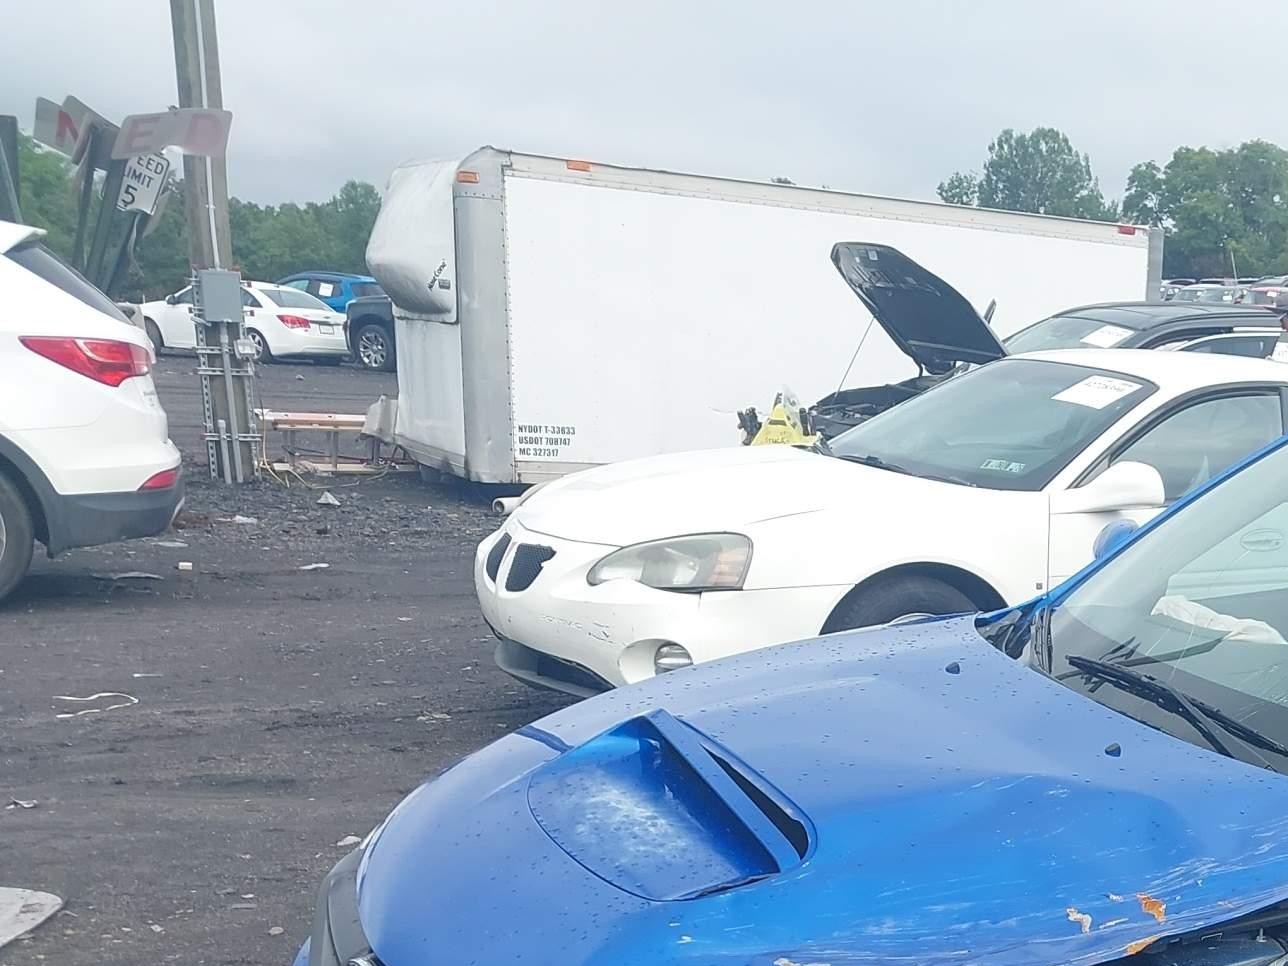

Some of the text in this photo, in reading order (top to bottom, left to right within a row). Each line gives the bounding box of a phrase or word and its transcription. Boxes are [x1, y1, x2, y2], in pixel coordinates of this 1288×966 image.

[137, 156, 164, 175] EED
[518, 425, 542, 433] NYDOT
[518, 436, 543, 445] USDOT
[519, 447, 559, 457] MC 327317
